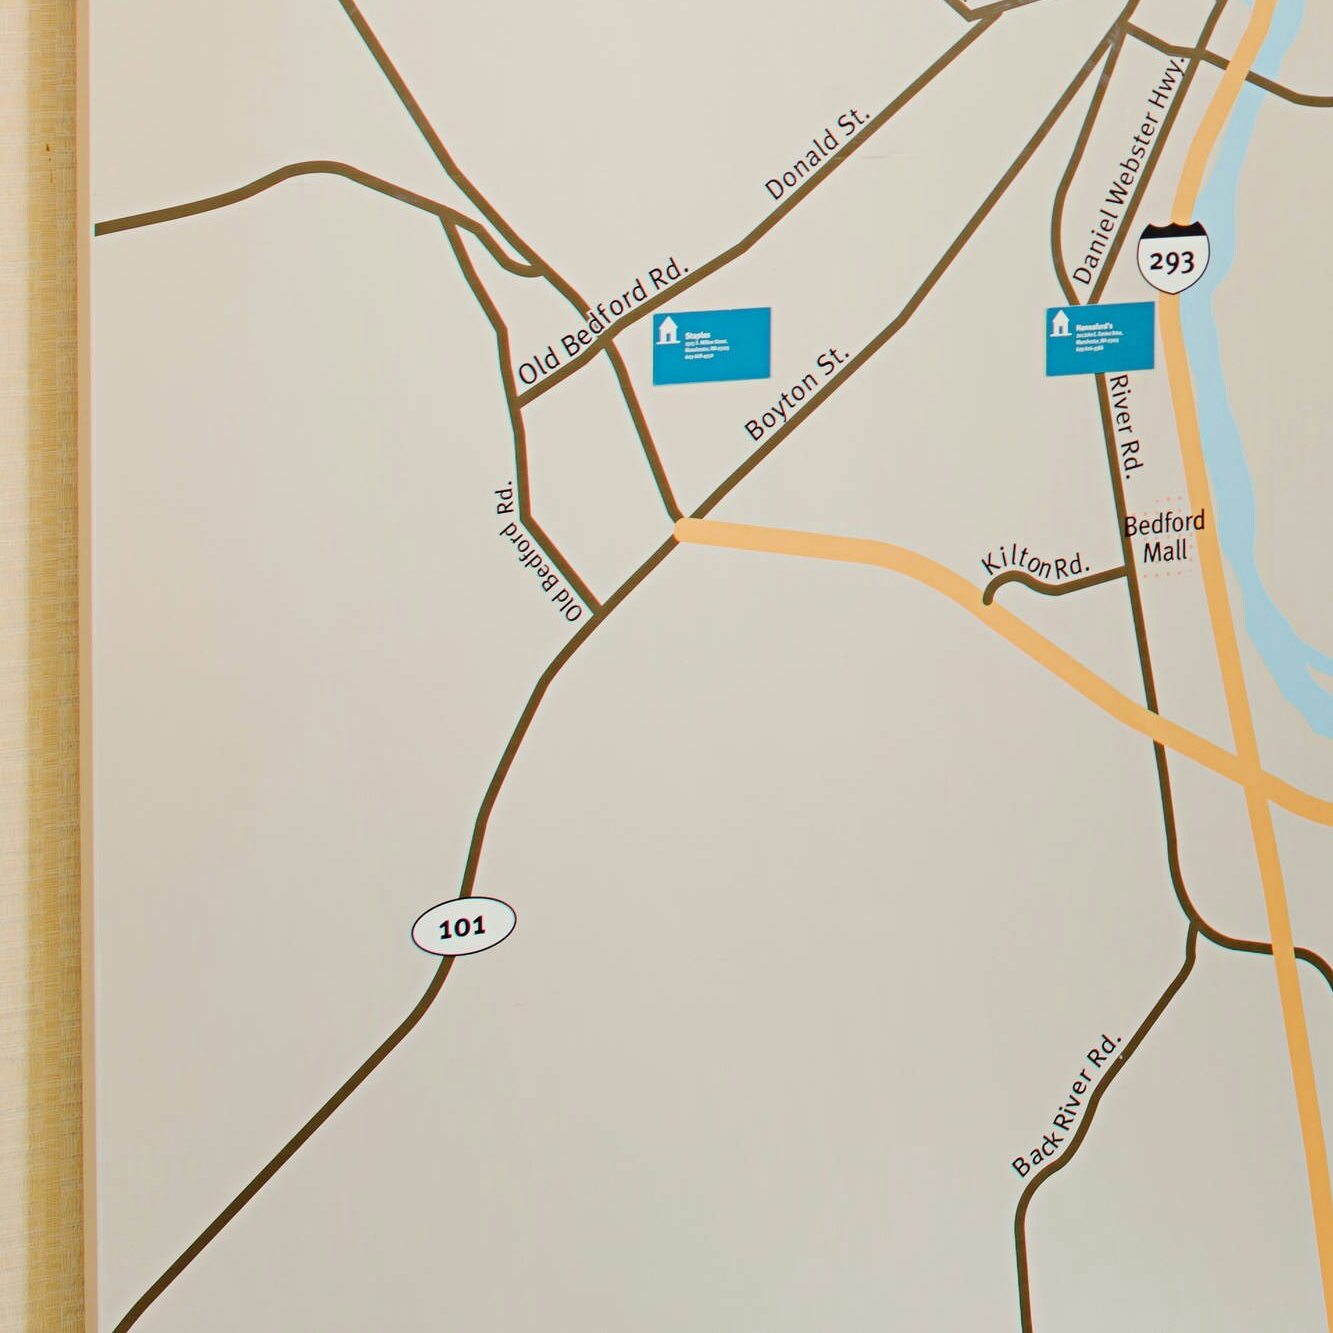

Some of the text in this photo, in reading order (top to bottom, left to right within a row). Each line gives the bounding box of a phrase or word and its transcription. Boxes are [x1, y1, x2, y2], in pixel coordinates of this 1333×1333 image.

[764, 107, 871, 200] Donald St.
[518, 352, 561, 385] Old
[561, 276, 646, 356] Bedford
[648, 256, 689, 291] Rd.
[685, 331, 711, 340] Staples
[1123, 508, 1206, 538] Bedford
[1143, 537, 1188, 564] Mall
[438, 917, 488, 942] 101
[1011, 1030, 1121, 1180] Back River Rd.
